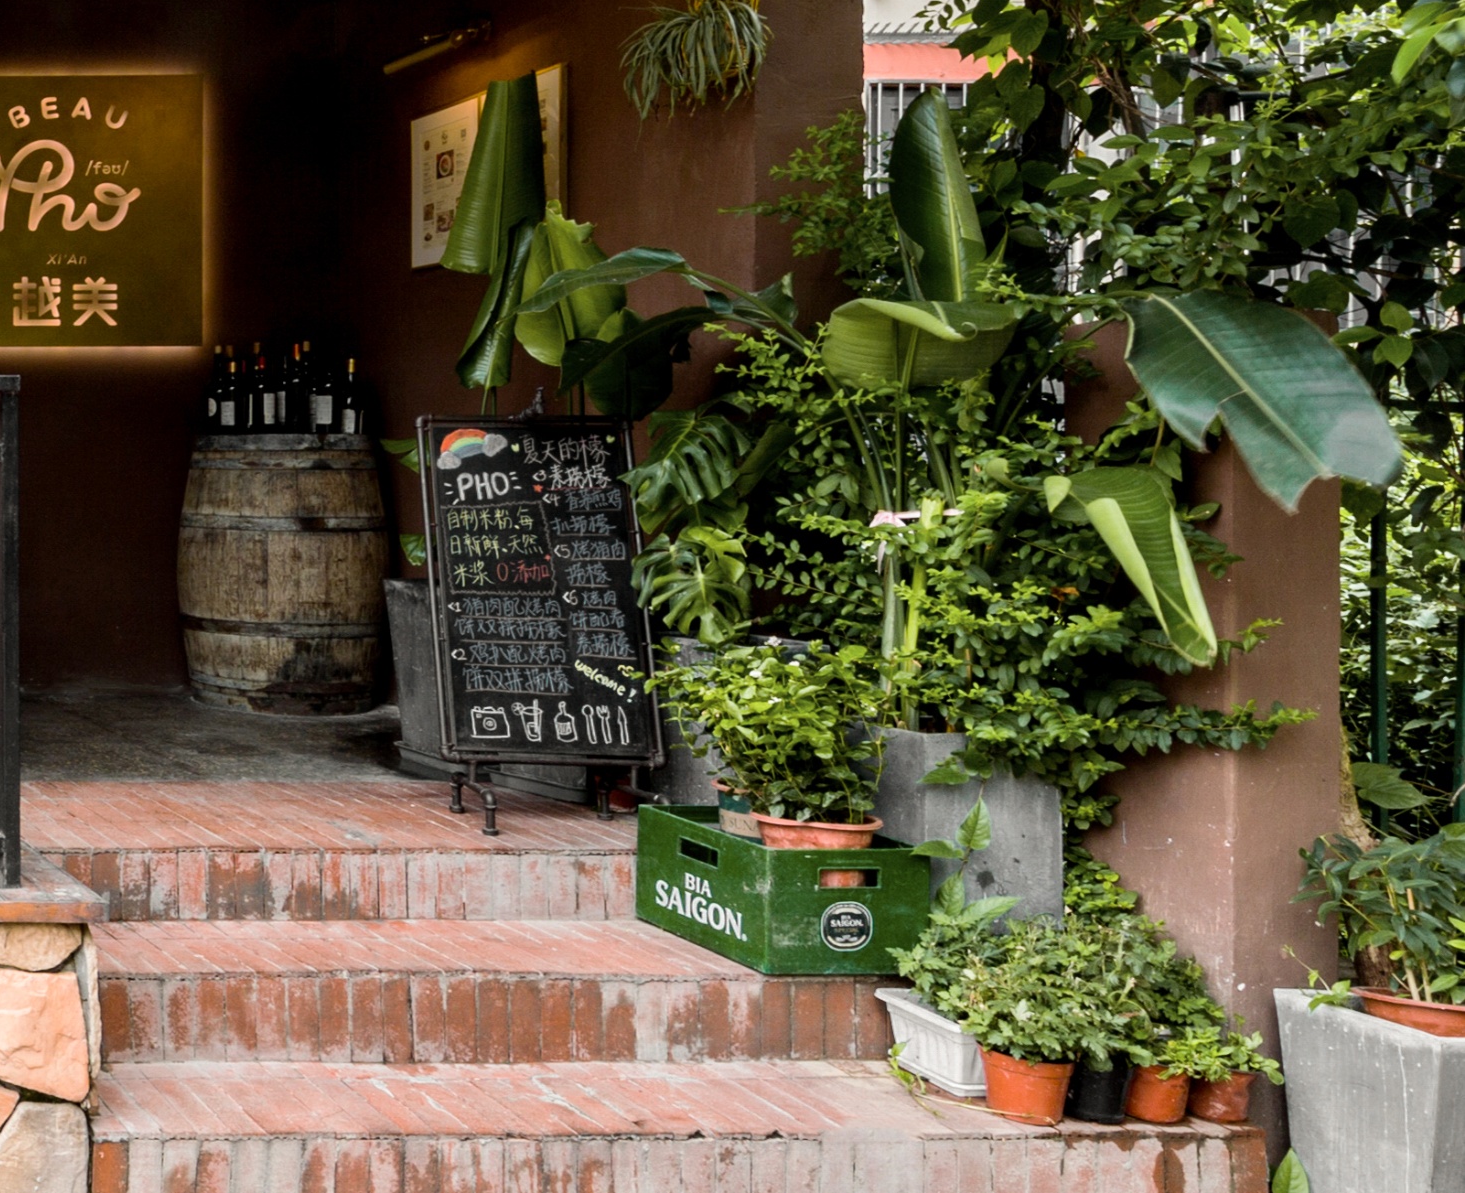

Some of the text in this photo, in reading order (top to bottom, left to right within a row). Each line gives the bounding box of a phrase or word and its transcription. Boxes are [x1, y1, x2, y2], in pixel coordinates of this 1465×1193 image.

[7, 96, 129, 129] BEAU
[13, 276, 118, 327] 越美
[456, 471, 510, 501] PHO
[684, 872, 712, 898] BIA
